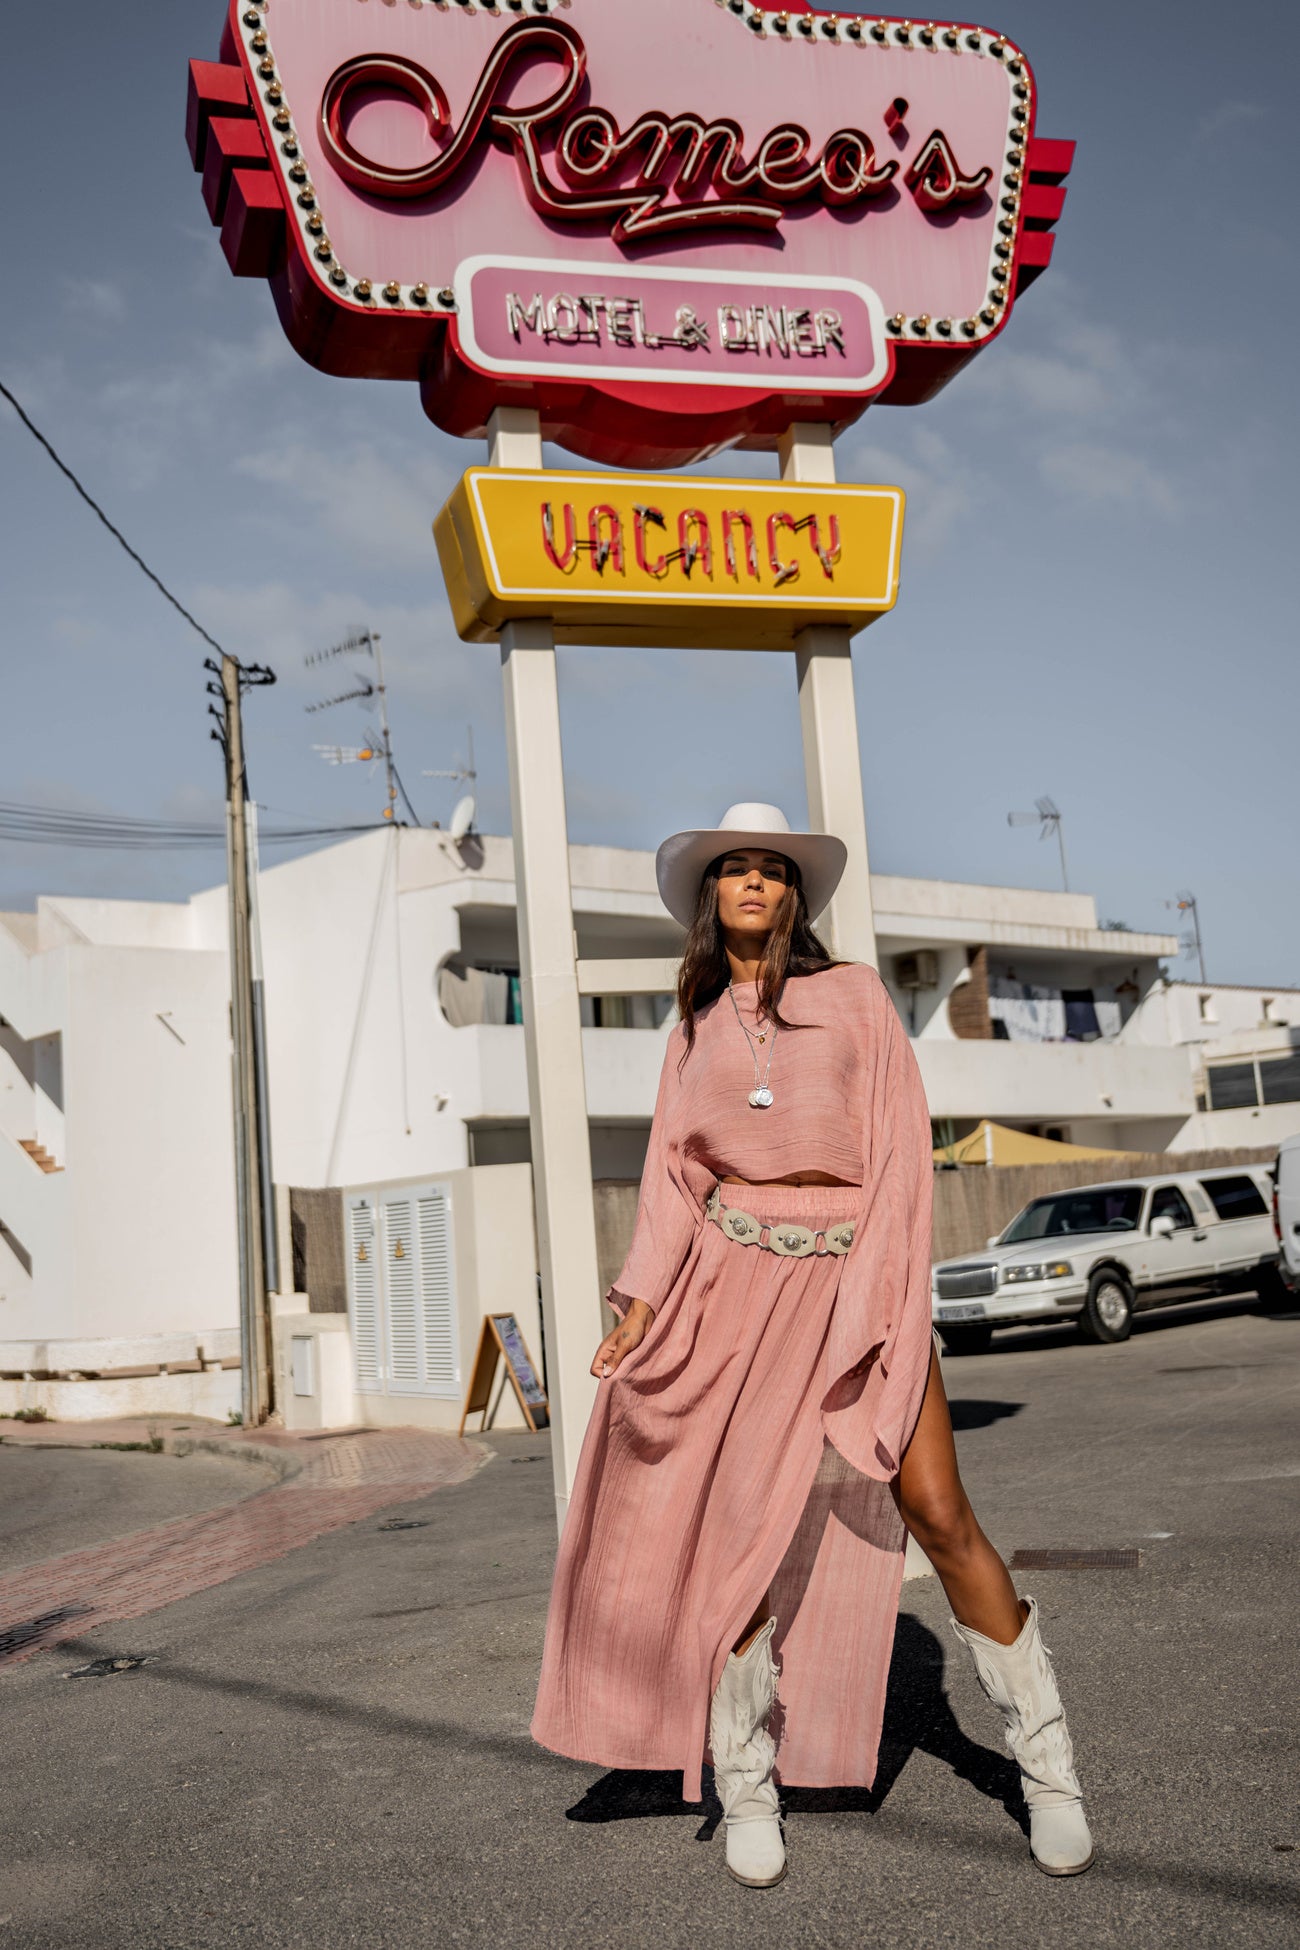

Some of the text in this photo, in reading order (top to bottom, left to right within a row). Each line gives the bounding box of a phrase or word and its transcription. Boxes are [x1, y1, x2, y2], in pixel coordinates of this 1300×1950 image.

[320, 16, 993, 240] Romeo's
[505, 292, 846, 357] MOTEL & DINER
[540, 502, 842, 585] VACANCY
